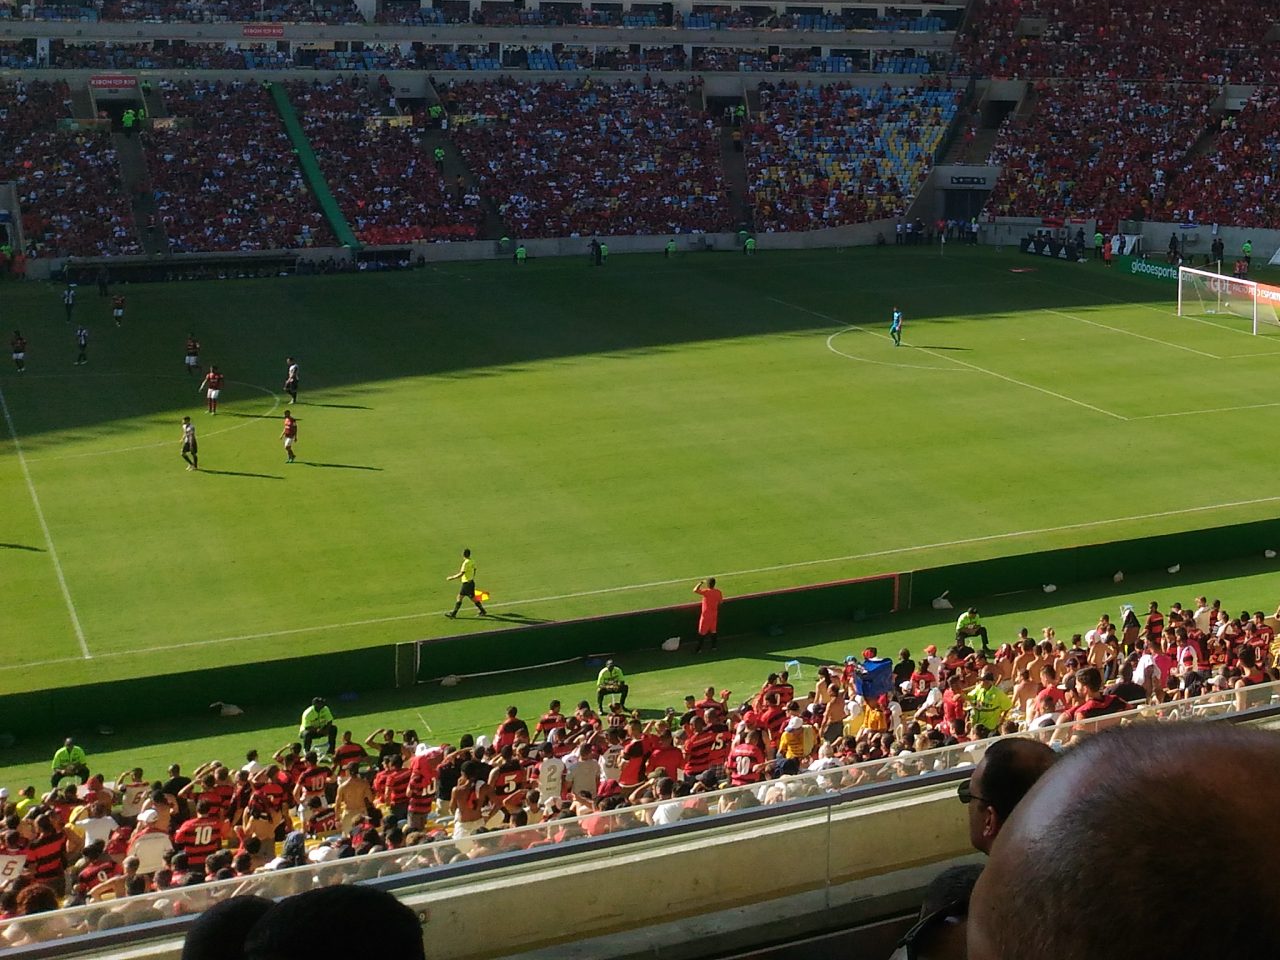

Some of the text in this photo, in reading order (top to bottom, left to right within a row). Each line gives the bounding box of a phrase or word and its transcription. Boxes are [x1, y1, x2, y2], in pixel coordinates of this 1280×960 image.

[1131, 260, 1195, 283] globoesporte.om
[546, 764, 557, 783] 2
[503, 774, 517, 793] 5
[194, 826, 213, 845] 10
